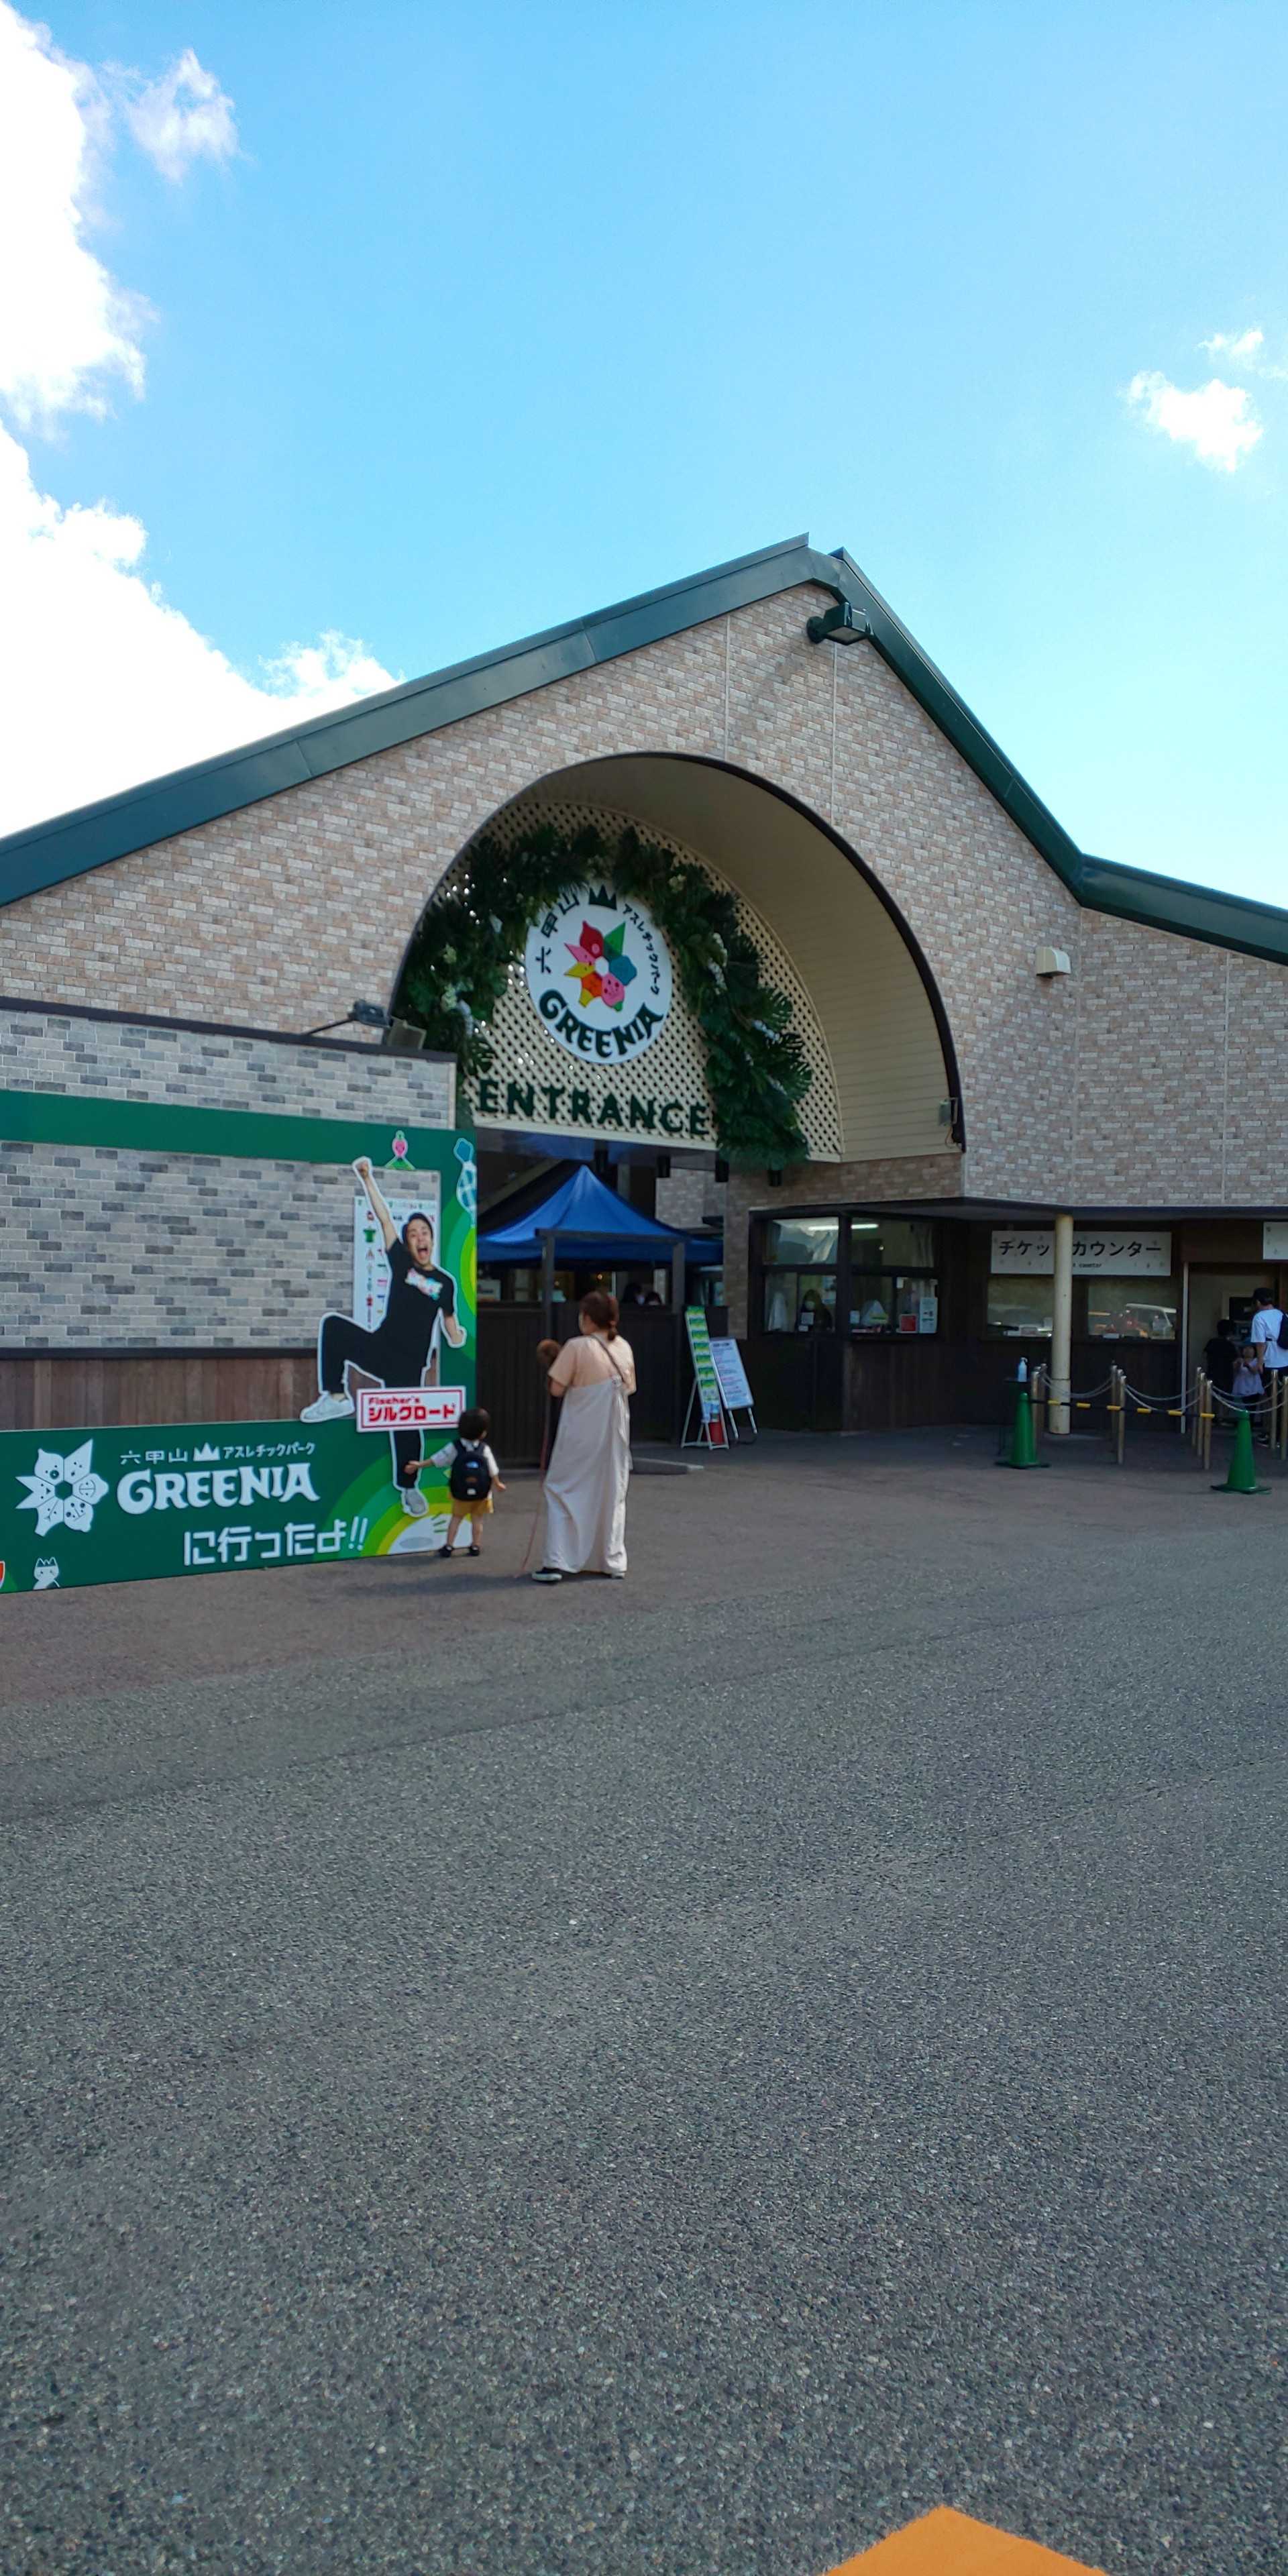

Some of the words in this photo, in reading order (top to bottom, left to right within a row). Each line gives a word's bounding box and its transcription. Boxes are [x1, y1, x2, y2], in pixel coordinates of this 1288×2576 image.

[535, 892, 580, 973] 六甲山
[623, 904, 660, 995] アスレチックパーク
[539, 988, 663, 1058] GREENIA
[478, 1079, 710, 1134] ENTRANCE
[999, 1241, 1162, 1256] チケッカウンター
[368, 1403, 456, 1421] シルクロード
[120, 1449, 188, 1464] 六甲山
[223, 1442, 315, 1459] アスレチックパーク
[117, 1462, 321, 1515] GREENIA
